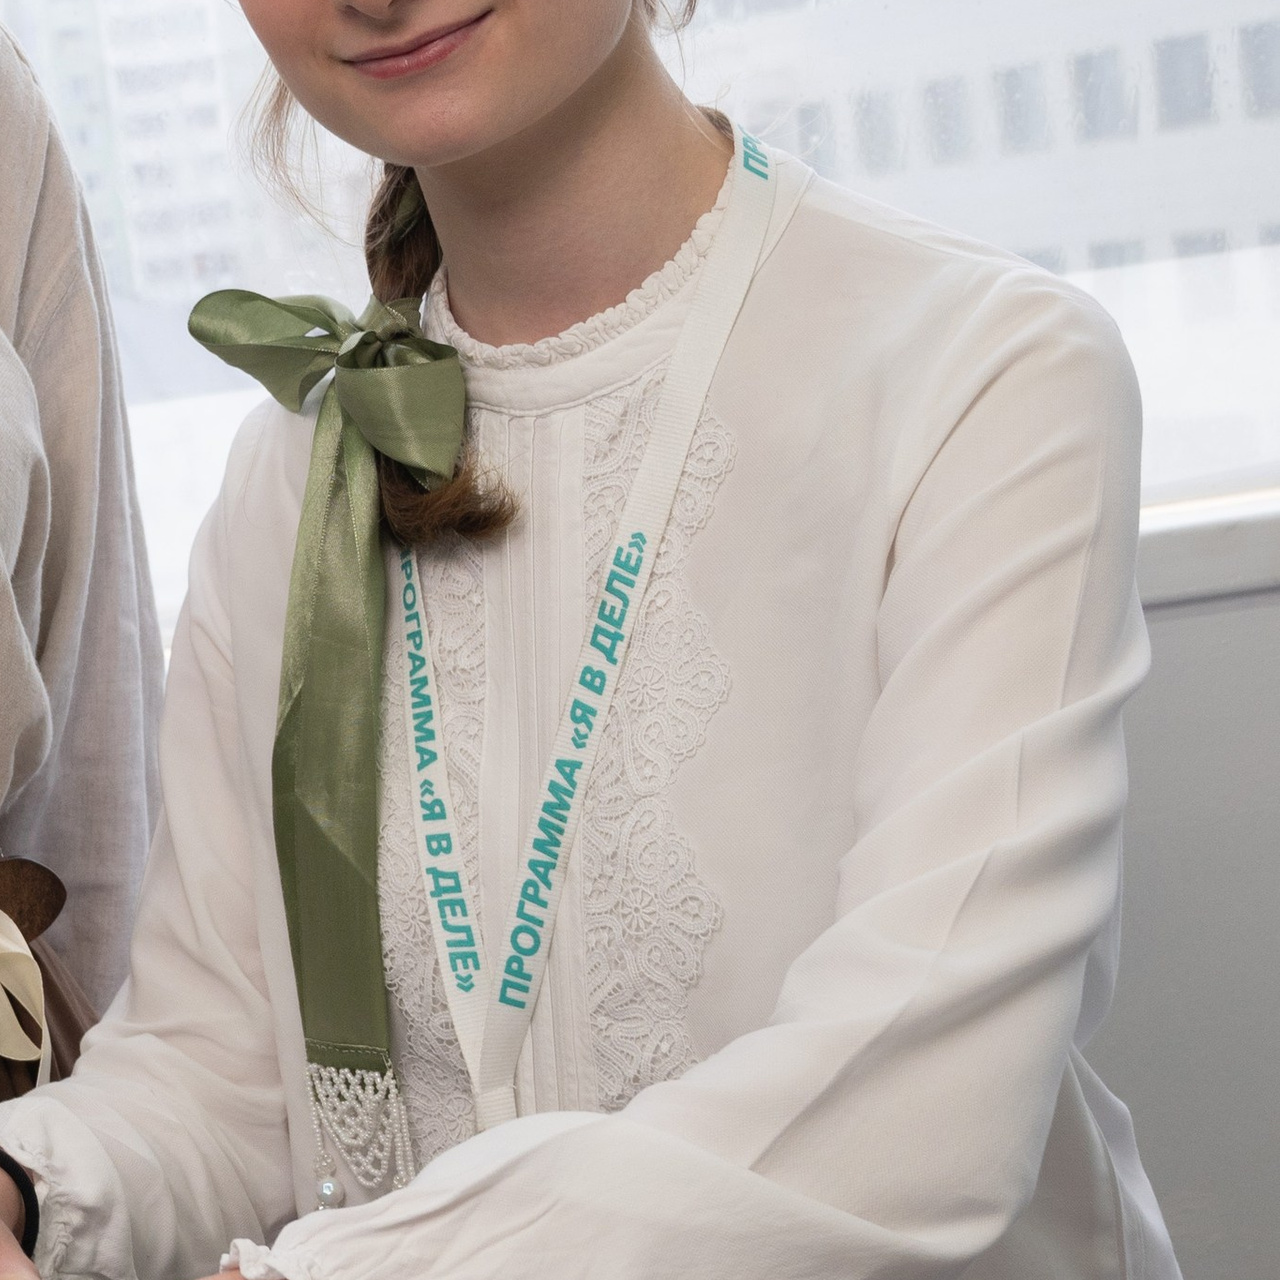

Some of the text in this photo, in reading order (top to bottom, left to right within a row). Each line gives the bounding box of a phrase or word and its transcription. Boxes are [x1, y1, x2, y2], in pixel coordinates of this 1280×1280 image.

[419, 778, 447, 822] «Я
[498, 530, 648, 1010] ПРОГРАММА «Я В ДЕЛЕ»
[425, 831, 454, 857] В
[426, 865, 481, 994] ДЕЛЕ»
